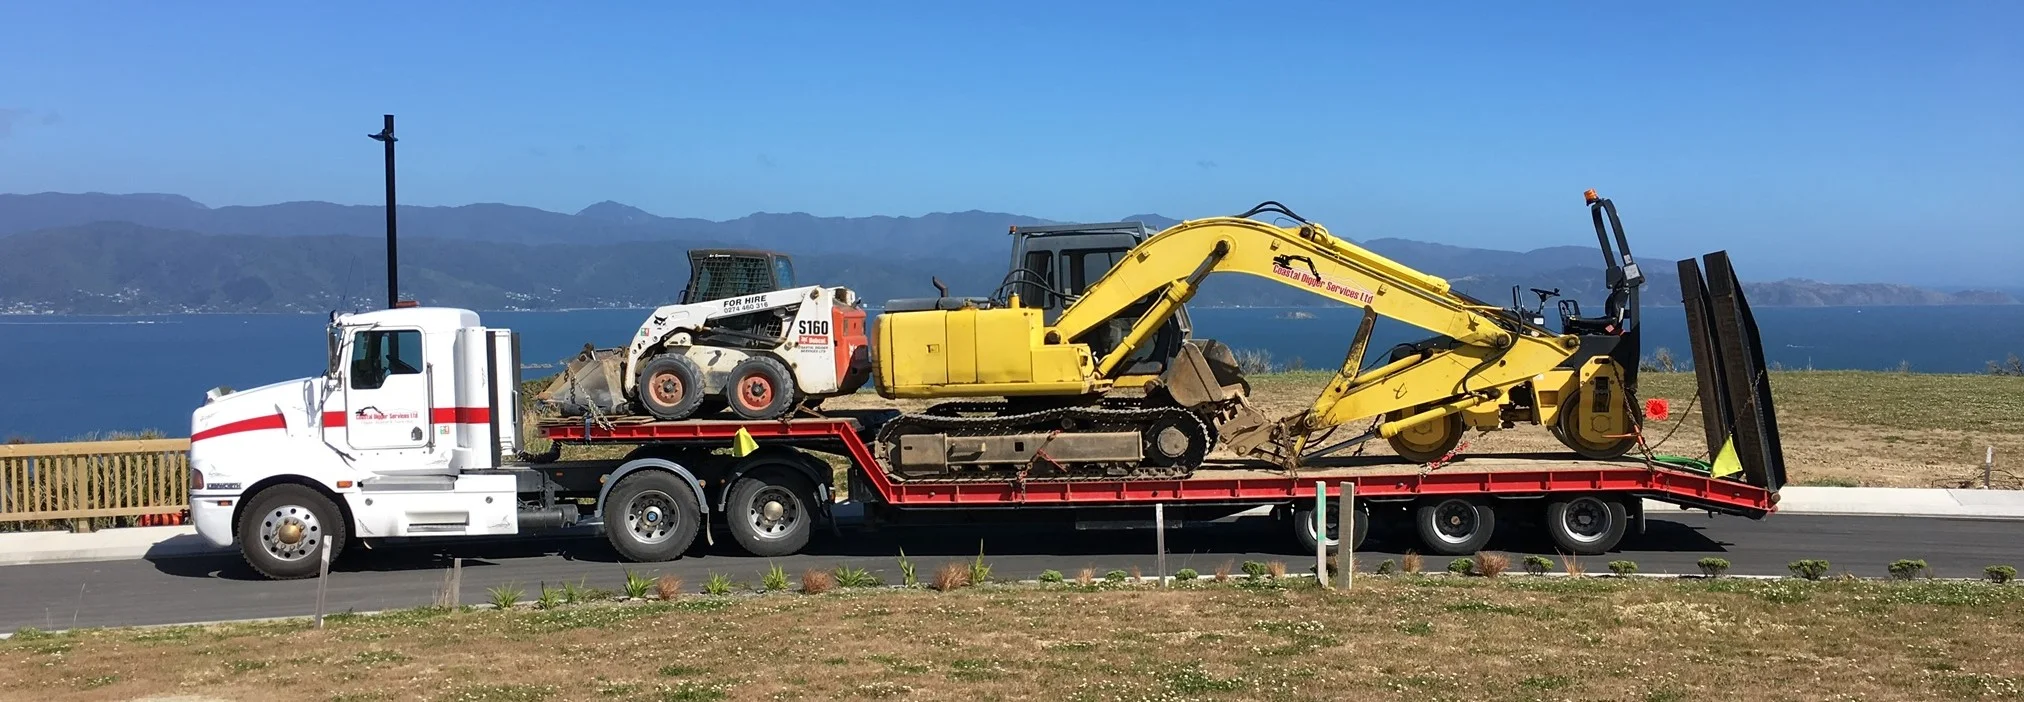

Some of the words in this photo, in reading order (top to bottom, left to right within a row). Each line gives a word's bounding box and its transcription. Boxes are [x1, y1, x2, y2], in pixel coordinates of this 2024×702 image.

[1273, 265, 1300, 280] Coastal
[1301, 273, 1325, 288] Digger
[1326, 281, 1359, 299] Services
[1360, 292, 1373, 304] Ltd
[724, 299, 741, 307] FOR
[745, 295, 766, 304] HIRE
[799, 320, 828, 335] S160
